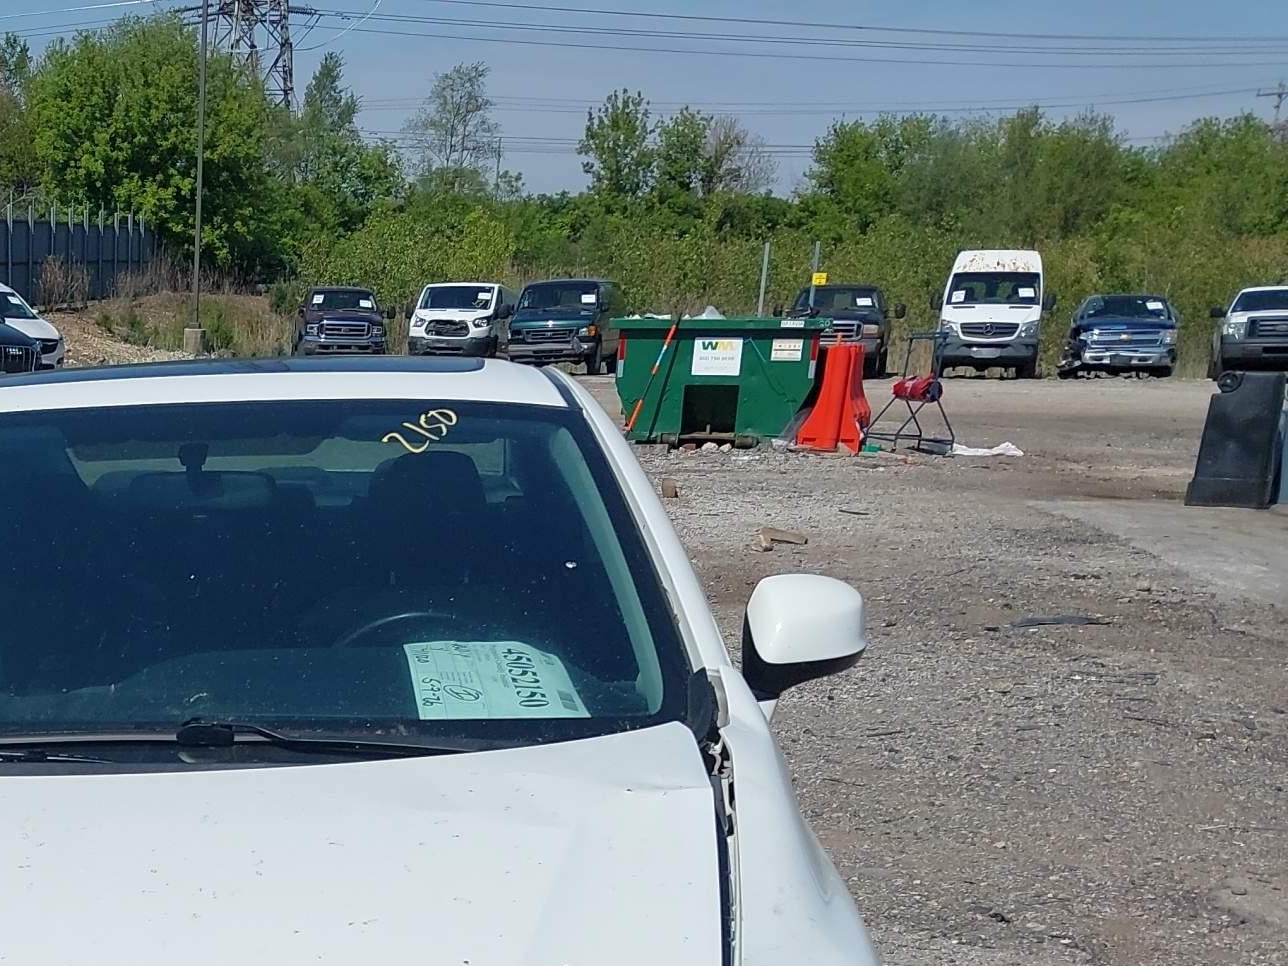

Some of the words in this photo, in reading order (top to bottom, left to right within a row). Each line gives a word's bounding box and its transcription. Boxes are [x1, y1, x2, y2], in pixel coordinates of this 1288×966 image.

[701, 341, 733, 350] WM
[381, 408, 457, 453] 2150
[502, 648, 550, 708] 45052150
